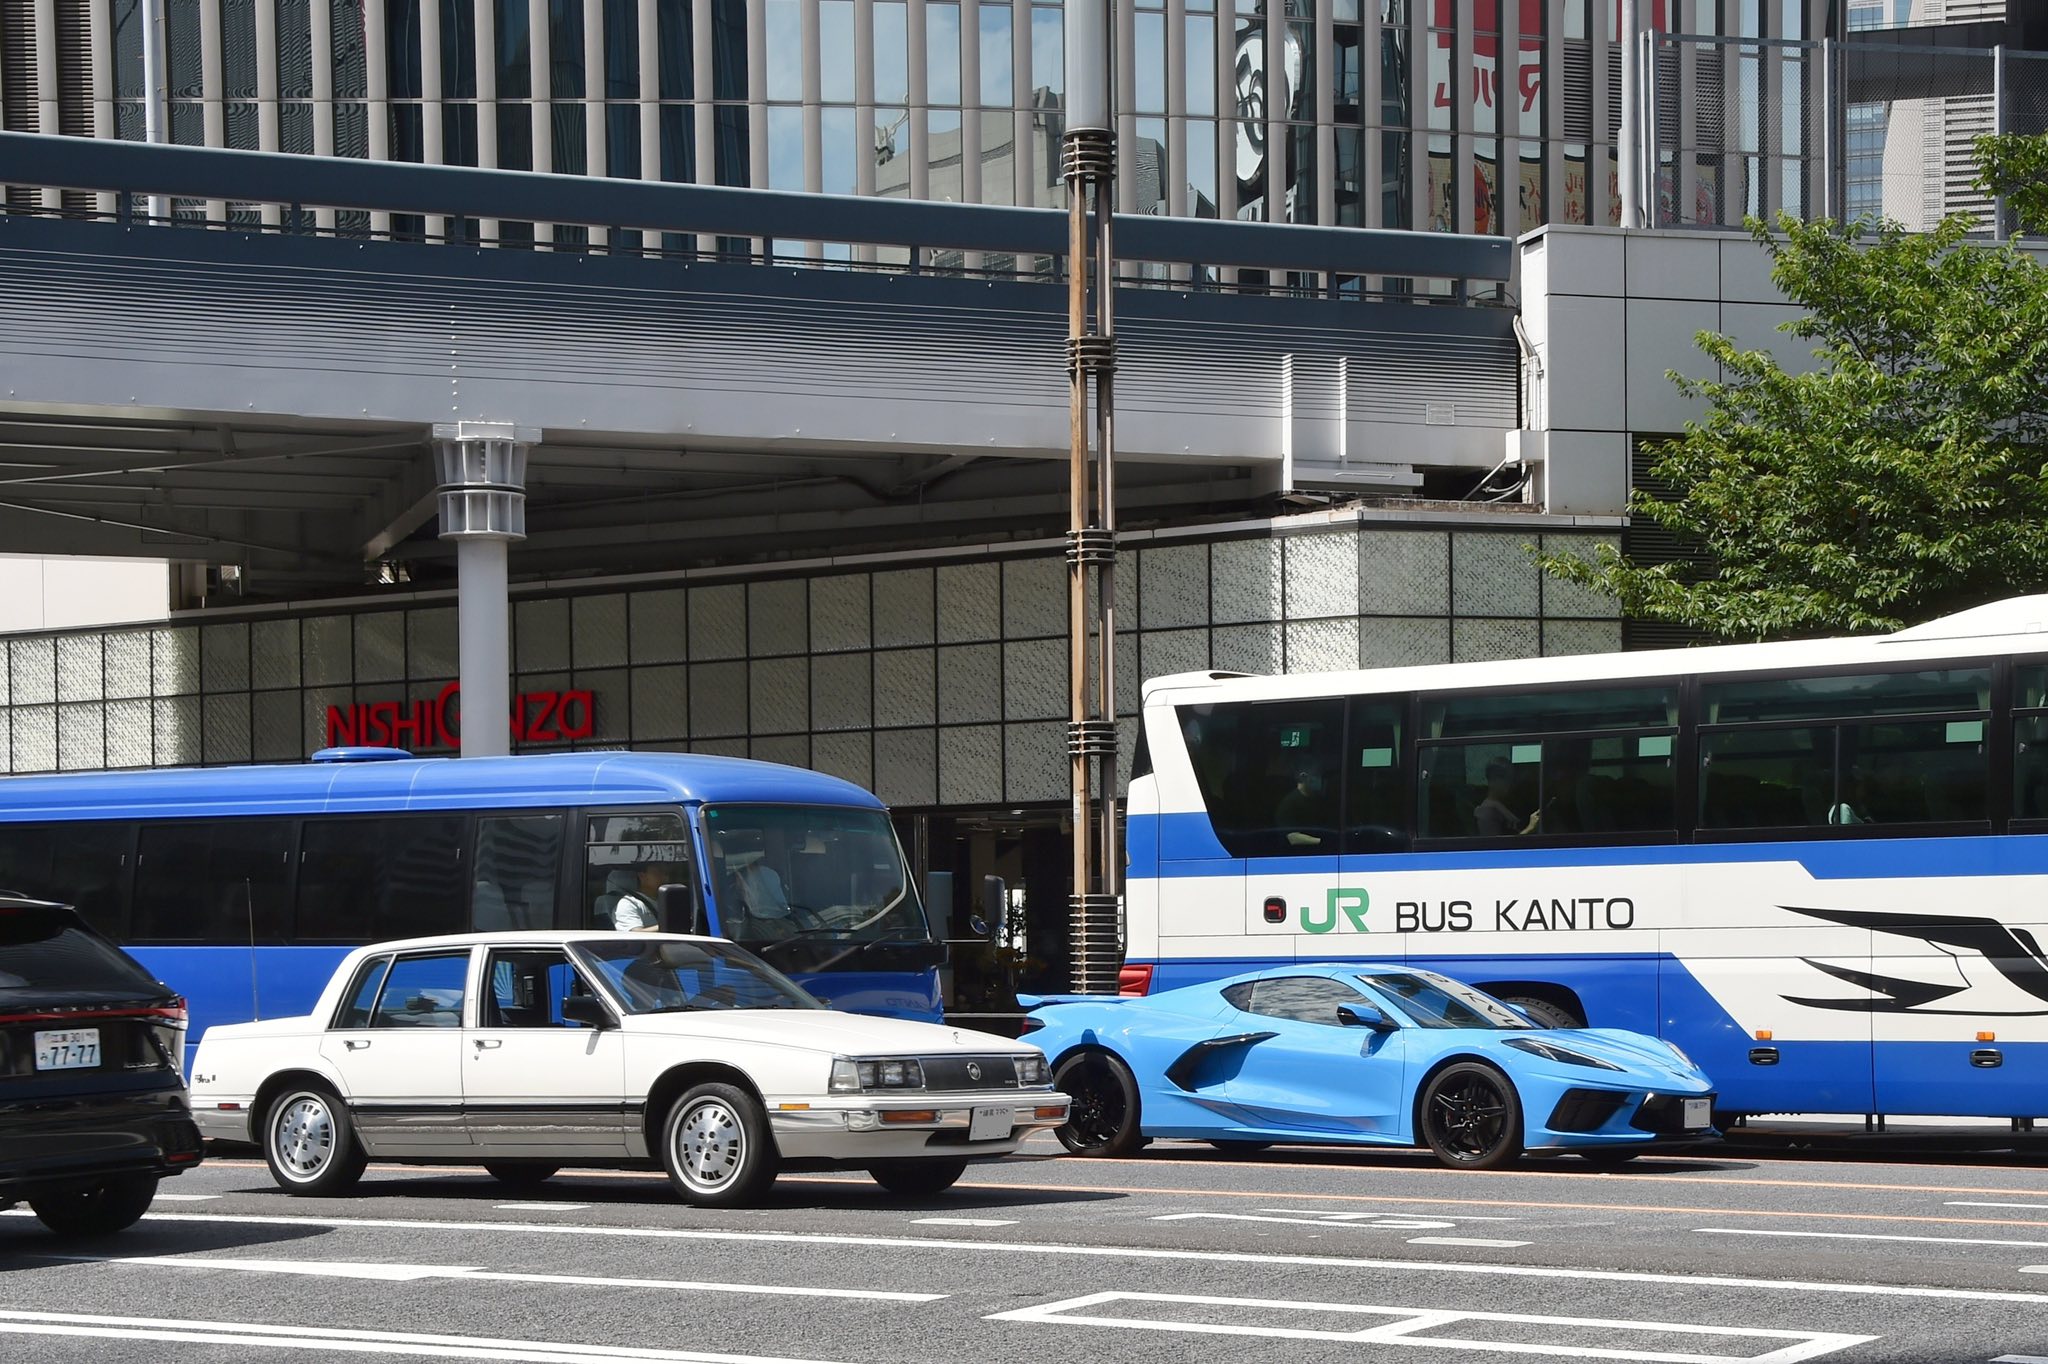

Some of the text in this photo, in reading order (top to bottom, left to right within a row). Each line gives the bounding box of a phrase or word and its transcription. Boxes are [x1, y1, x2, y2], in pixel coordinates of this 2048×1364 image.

[1300, 888, 1634, 933] JR BUS KANTO
[35, 1005, 111, 1013] LEXUS
